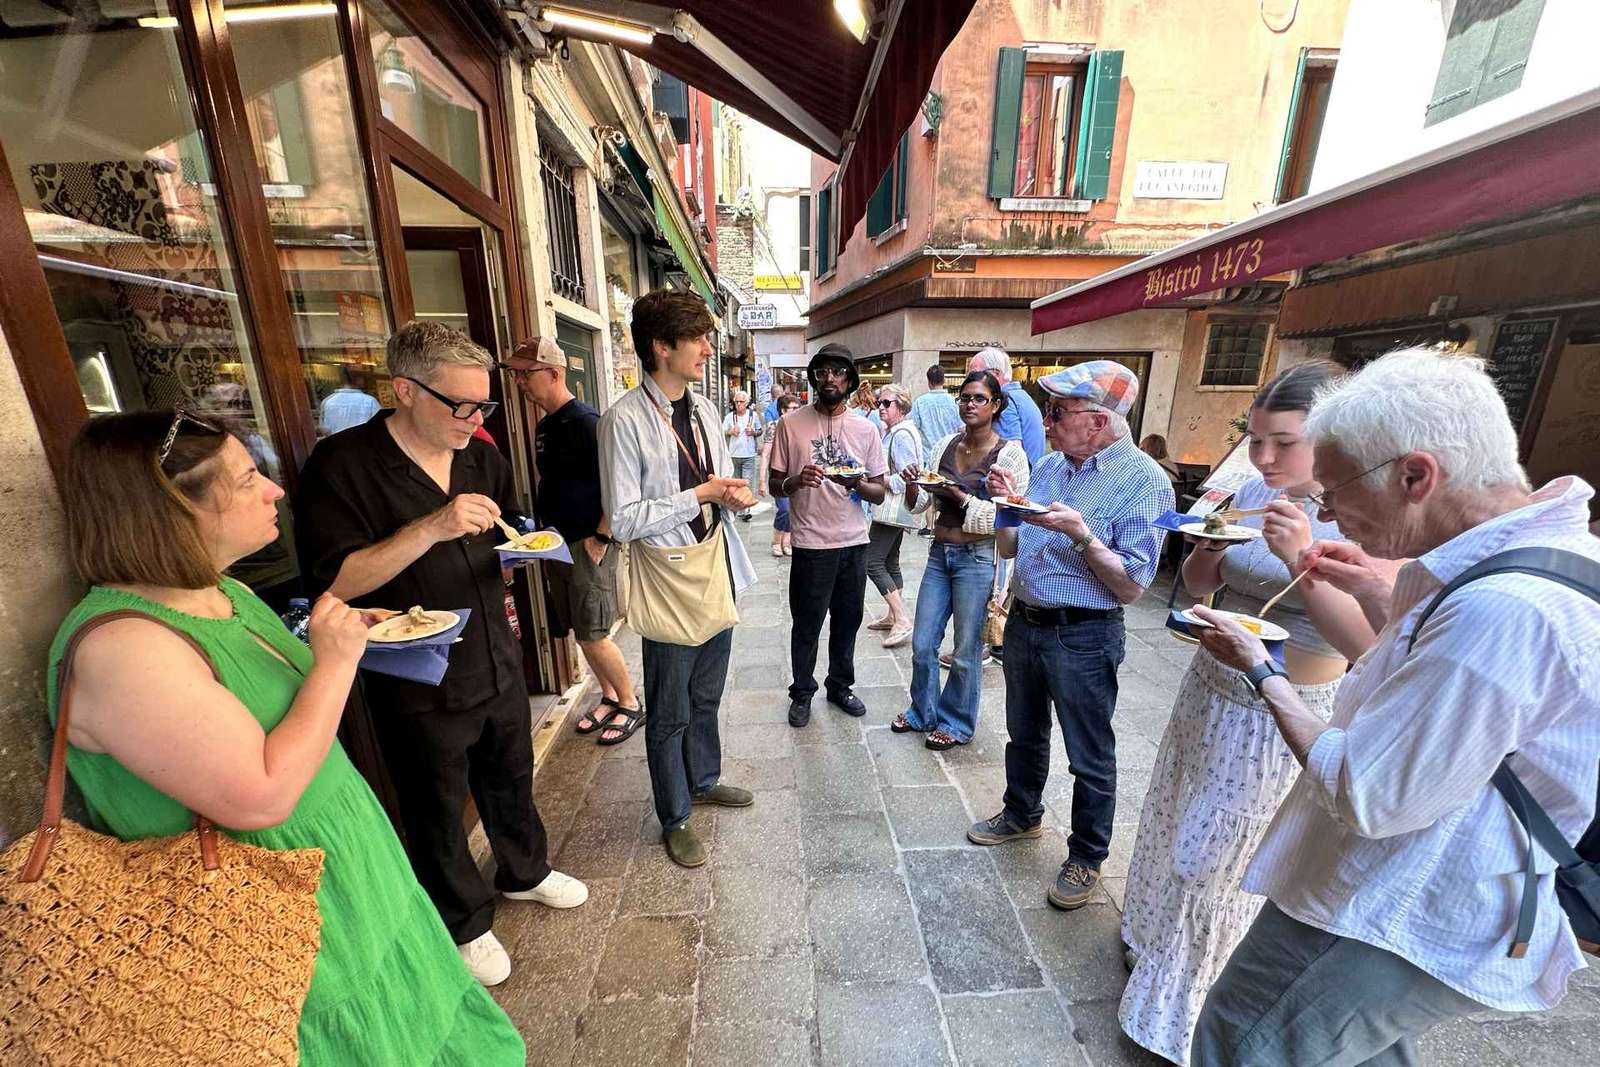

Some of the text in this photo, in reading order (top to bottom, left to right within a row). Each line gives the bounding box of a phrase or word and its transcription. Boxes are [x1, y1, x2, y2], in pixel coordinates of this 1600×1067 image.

[1144, 237, 1264, 300] Bistrò 1473
[750, 311, 772, 320] BAR
